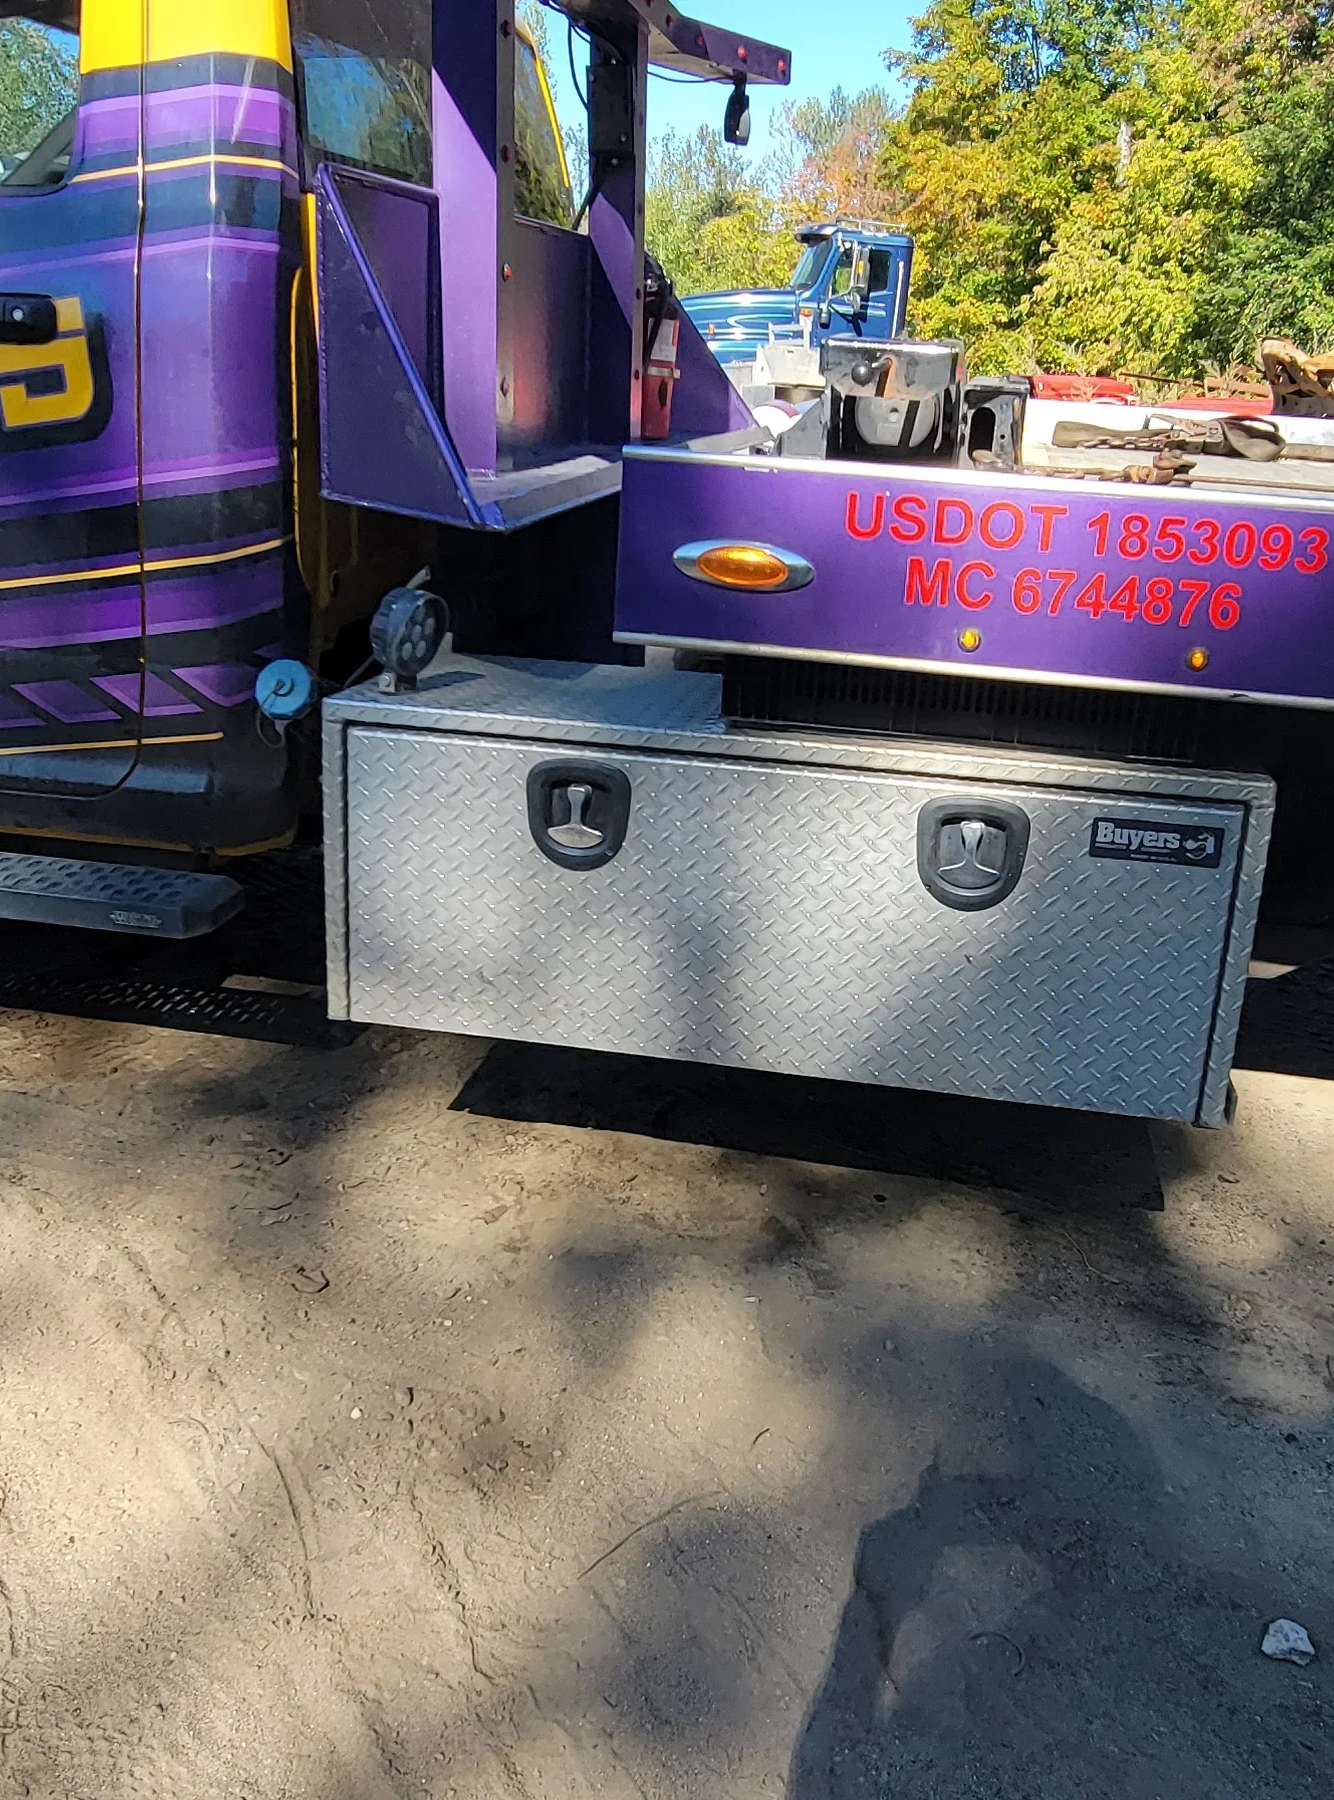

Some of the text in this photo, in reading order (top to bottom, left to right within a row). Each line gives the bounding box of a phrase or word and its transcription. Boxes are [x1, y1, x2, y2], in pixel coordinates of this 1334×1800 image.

[844, 491, 1330, 575] USDOT 1853093
[903, 557, 1242, 631] MC 6744876
[1095, 821, 1181, 851] Buyers
